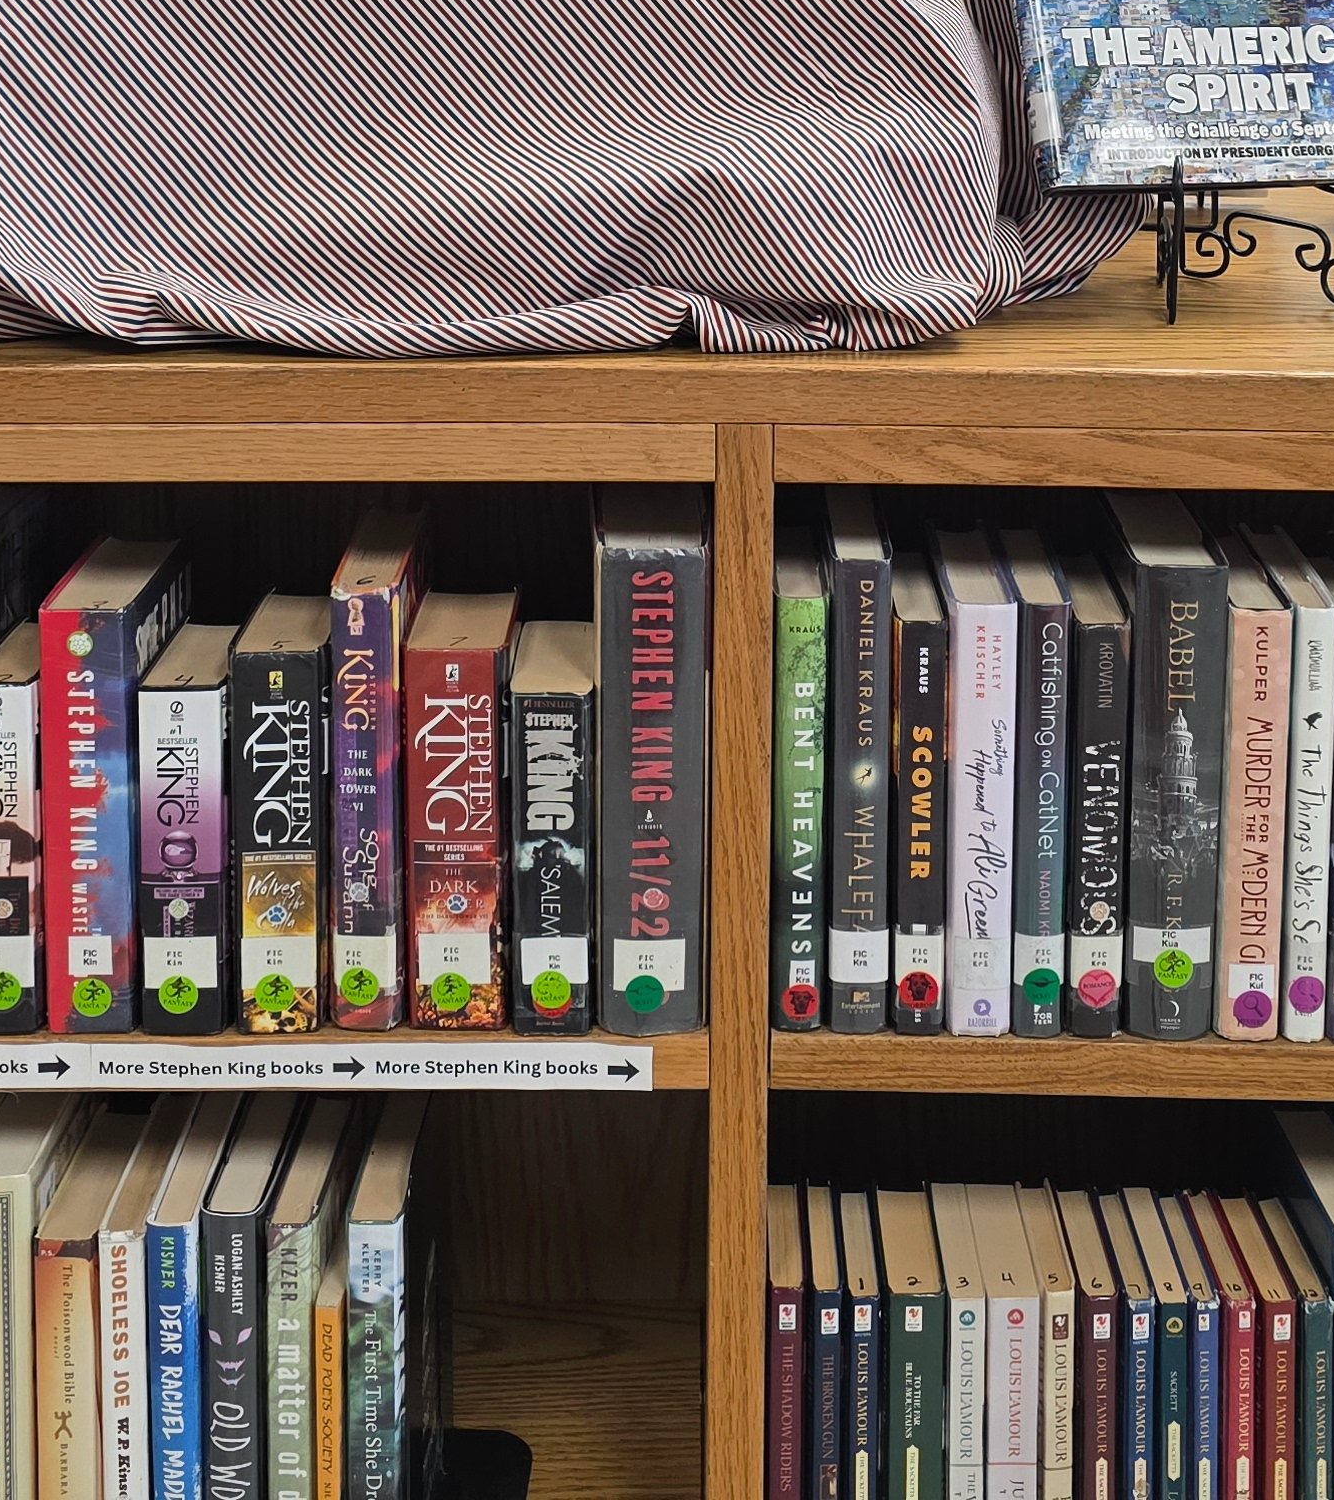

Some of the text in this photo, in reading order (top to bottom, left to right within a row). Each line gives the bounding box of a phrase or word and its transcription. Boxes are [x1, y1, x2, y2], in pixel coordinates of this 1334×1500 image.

[1061, 26, 1158, 67] THE
[1165, 72, 1314, 113] SPIRIT
[1084, 123, 1154, 142] Meeting
[1156, 123, 1184, 138] the
[1186, 121, 1270, 142] Challenge
[1272, 120, 1290, 137] of
[1203, 147, 1219, 159] BY
[1222, 146, 1290, 159] PRESIDENT
[858, 581, 875, 747] DANIEL KRAUS
[1167, 599, 1199, 711] BABEL
[1253, 626, 1269, 703] KULPER
[348, 750, 368, 760] THE
[1034, 622, 1064, 859] Catfishing ON CatNet
[340, 783, 377, 795] TOWER
[343, 766, 373, 778] DARK
[791, 683, 815, 955] BENT HEAVENS
[910, 725, 933, 880] SCOWLER
[375, 1058, 599, 1078] More Stephen King books
[160, 1236, 176, 1289] KISNER
[109, 1245, 131, 1408] SHOELESS JOE
[1008, 1337, 1022, 1459] LOUIS L'AMOUR
